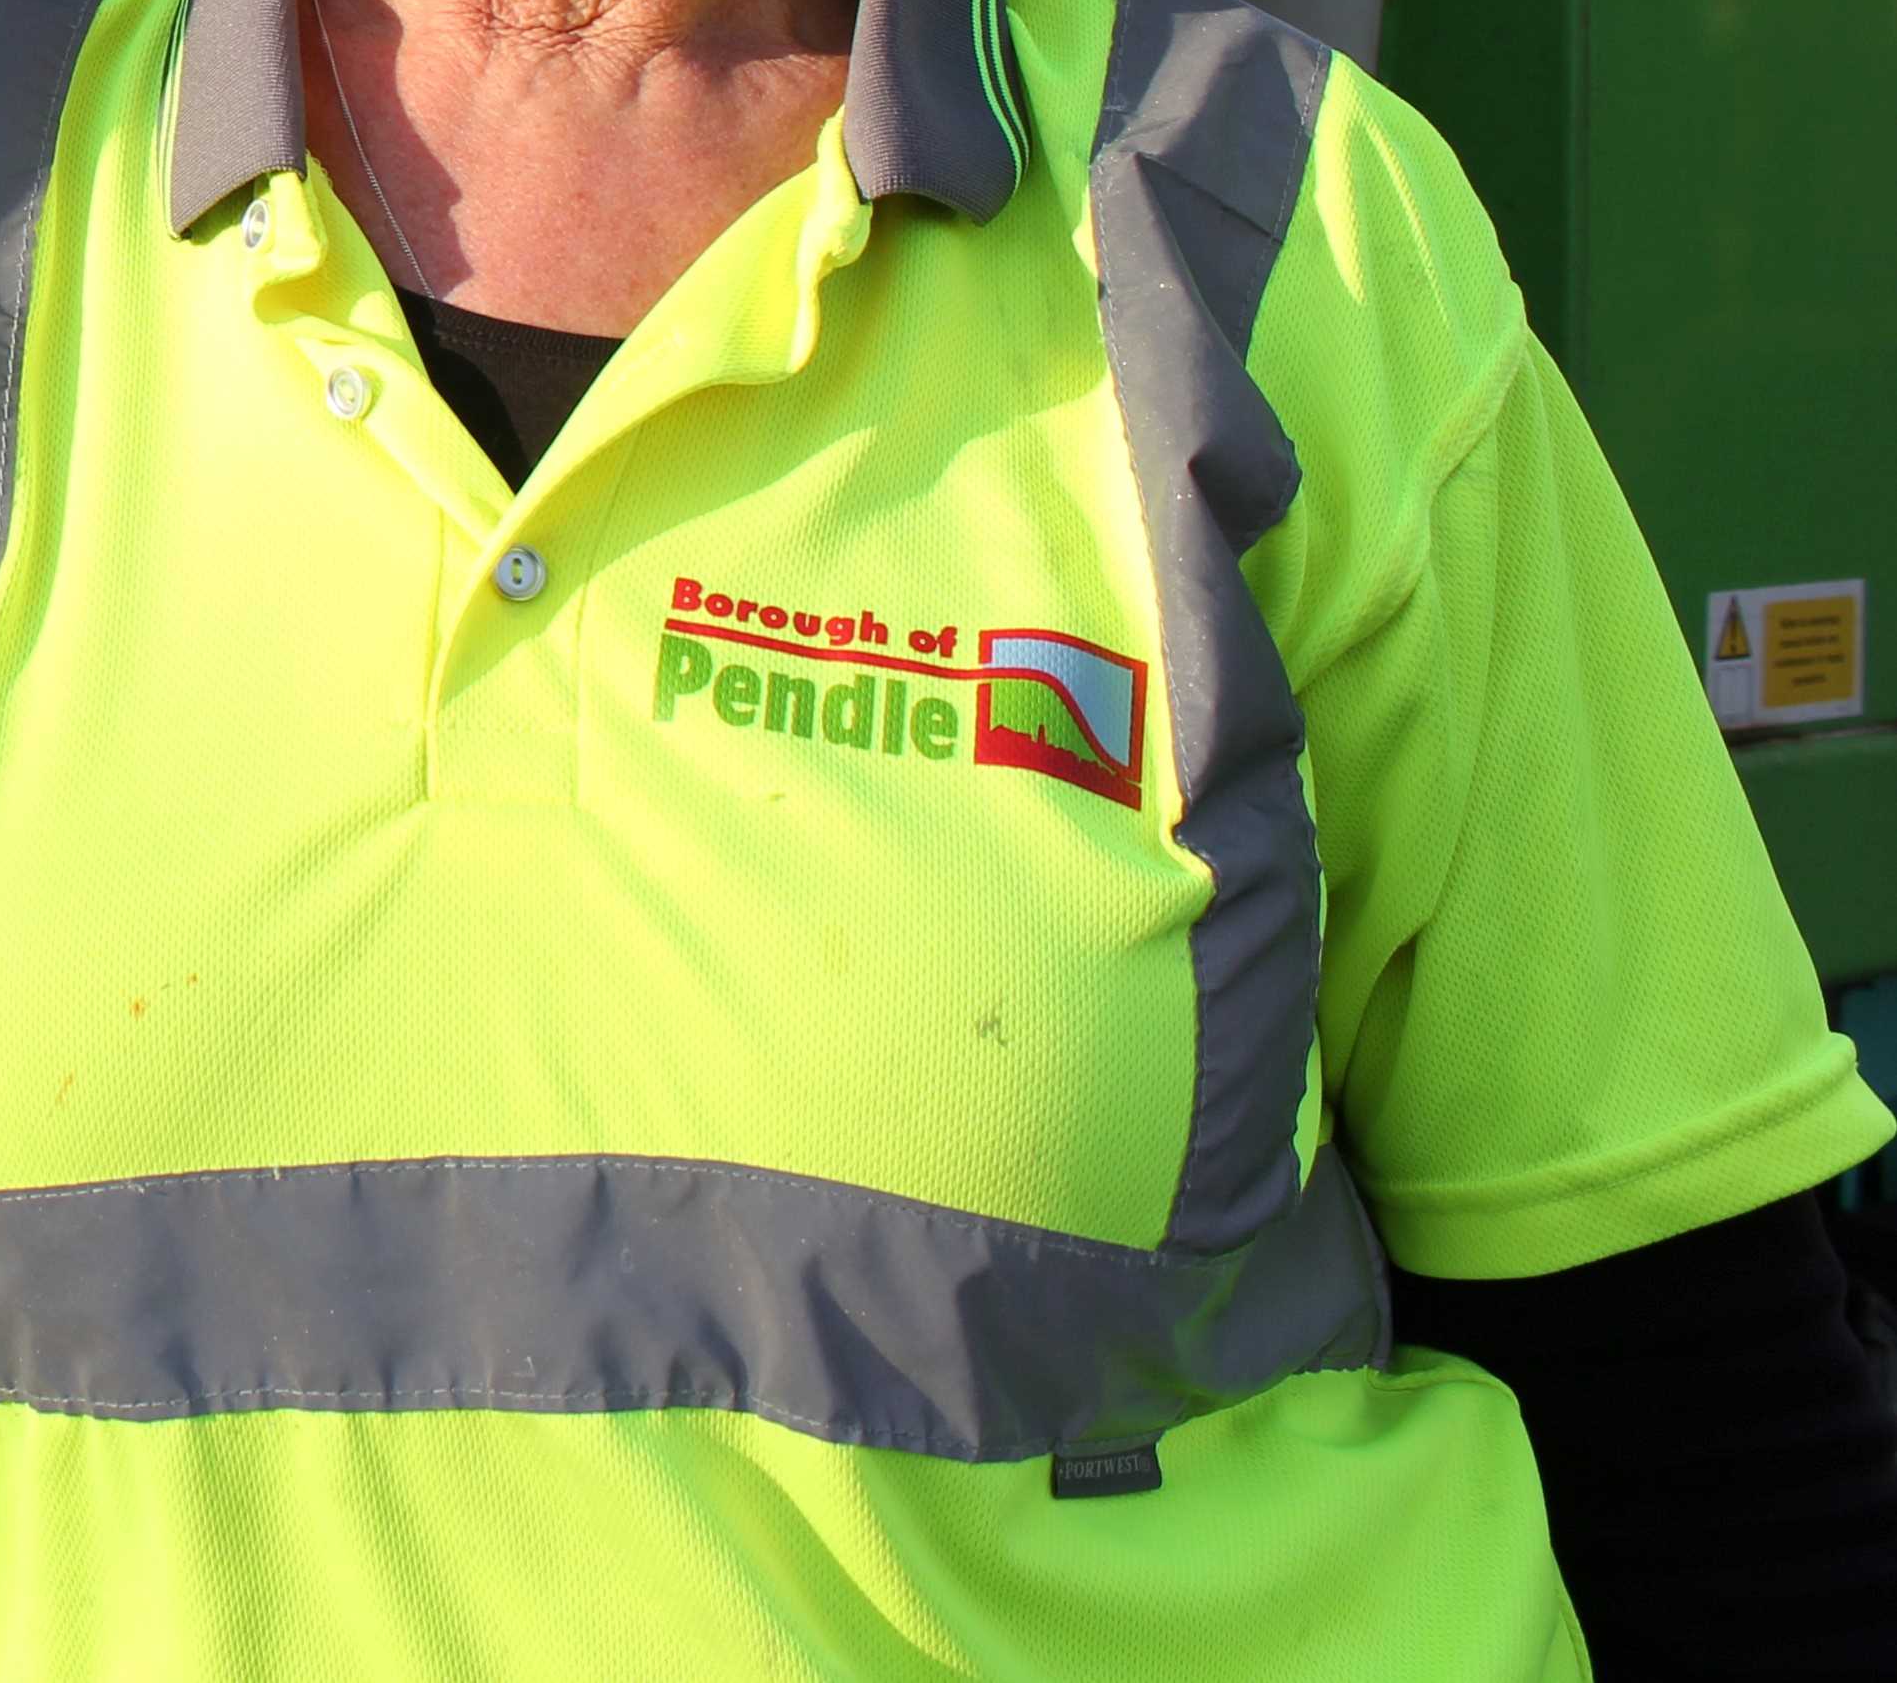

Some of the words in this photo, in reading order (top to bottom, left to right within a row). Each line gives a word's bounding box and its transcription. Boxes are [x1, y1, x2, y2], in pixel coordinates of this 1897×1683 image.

[671, 576, 890, 646] Borough
[908, 625, 959, 659] of
[652, 632, 960, 761] Pendle
